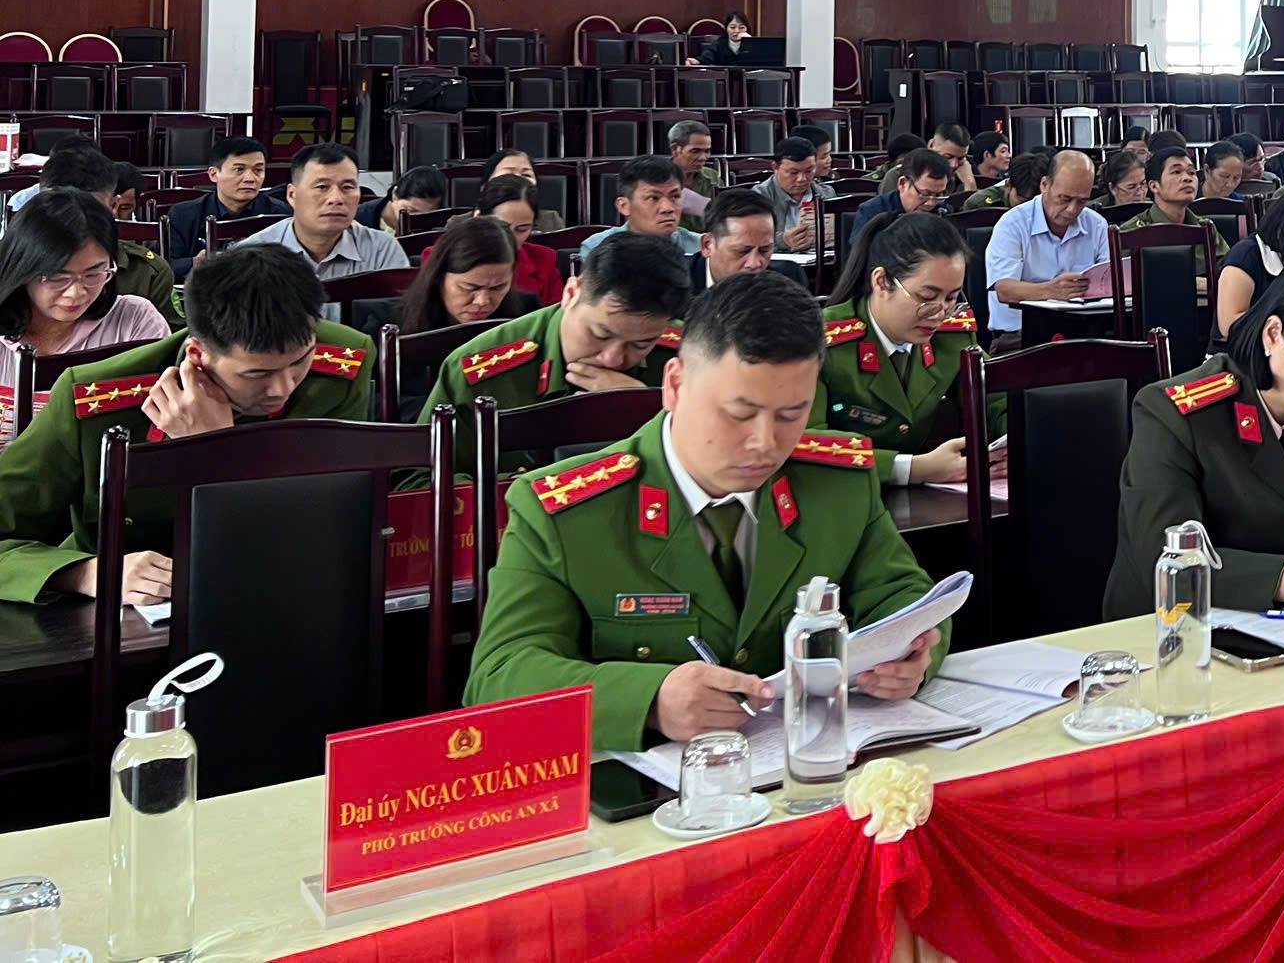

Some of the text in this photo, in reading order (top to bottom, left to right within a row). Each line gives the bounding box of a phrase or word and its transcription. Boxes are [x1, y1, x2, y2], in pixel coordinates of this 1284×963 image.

[340, 751, 580, 829] Đại úy NGẠC XUÂN NAM
[361, 834, 397, 856] PHÓ
[468, 807, 513, 832] CÔNG
[516, 802, 538, 821] AN
[538, 795, 561, 816] XÃ
